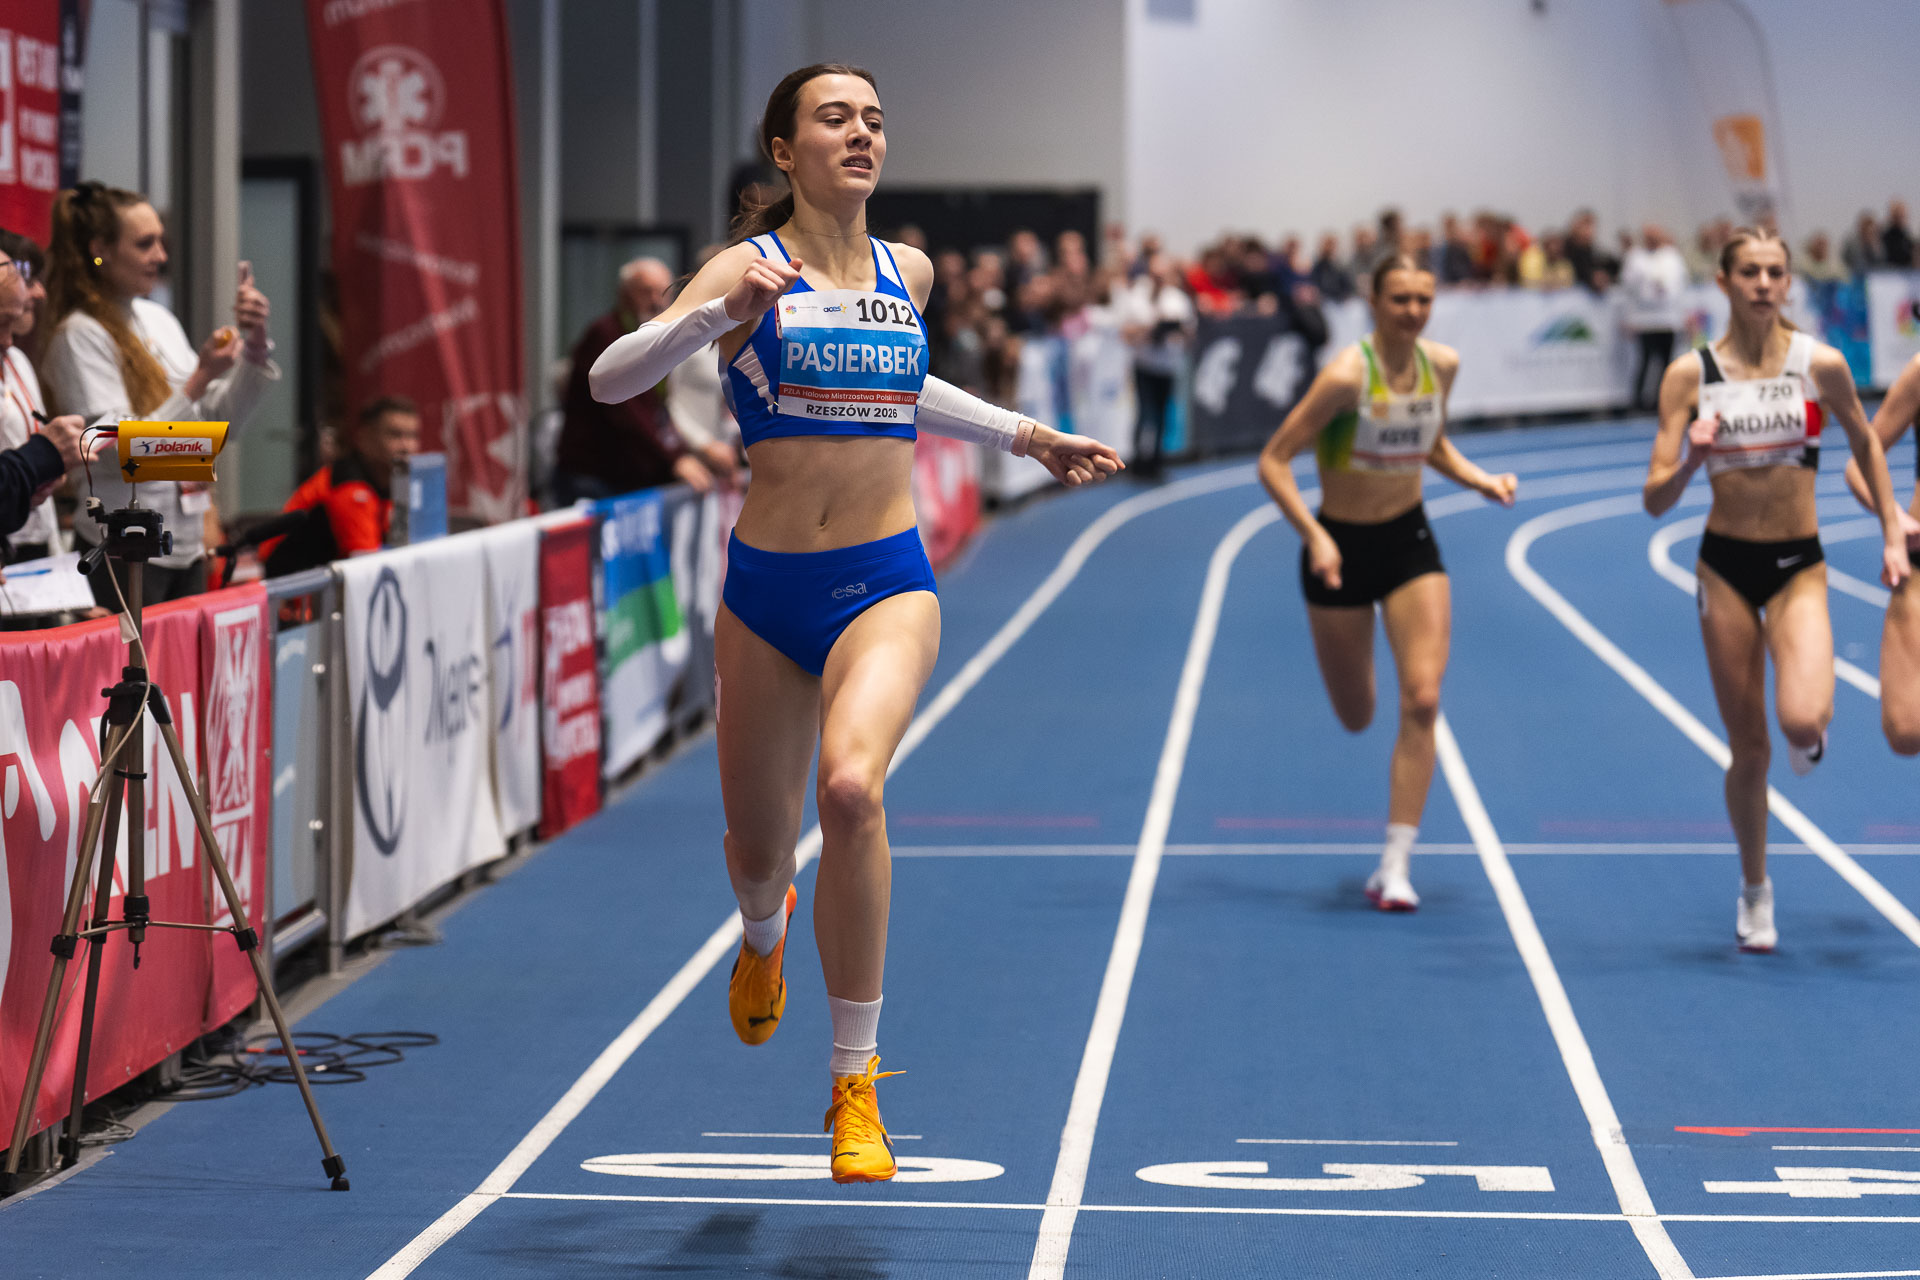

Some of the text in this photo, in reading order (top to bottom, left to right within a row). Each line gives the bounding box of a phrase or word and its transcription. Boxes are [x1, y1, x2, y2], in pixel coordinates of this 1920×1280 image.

[856, 298, 917, 328] 1012
[786, 341, 922, 376] PASIERBEK
[783, 387, 801, 396] PZLA
[802, 390, 830, 400] Halowe
[831, 393, 875, 401] Mistrzostwa
[806, 404, 898, 419] RZESZÓW 2026
[154, 441, 203, 455] polanik
[1135, 1161, 1555, 1192] 5
